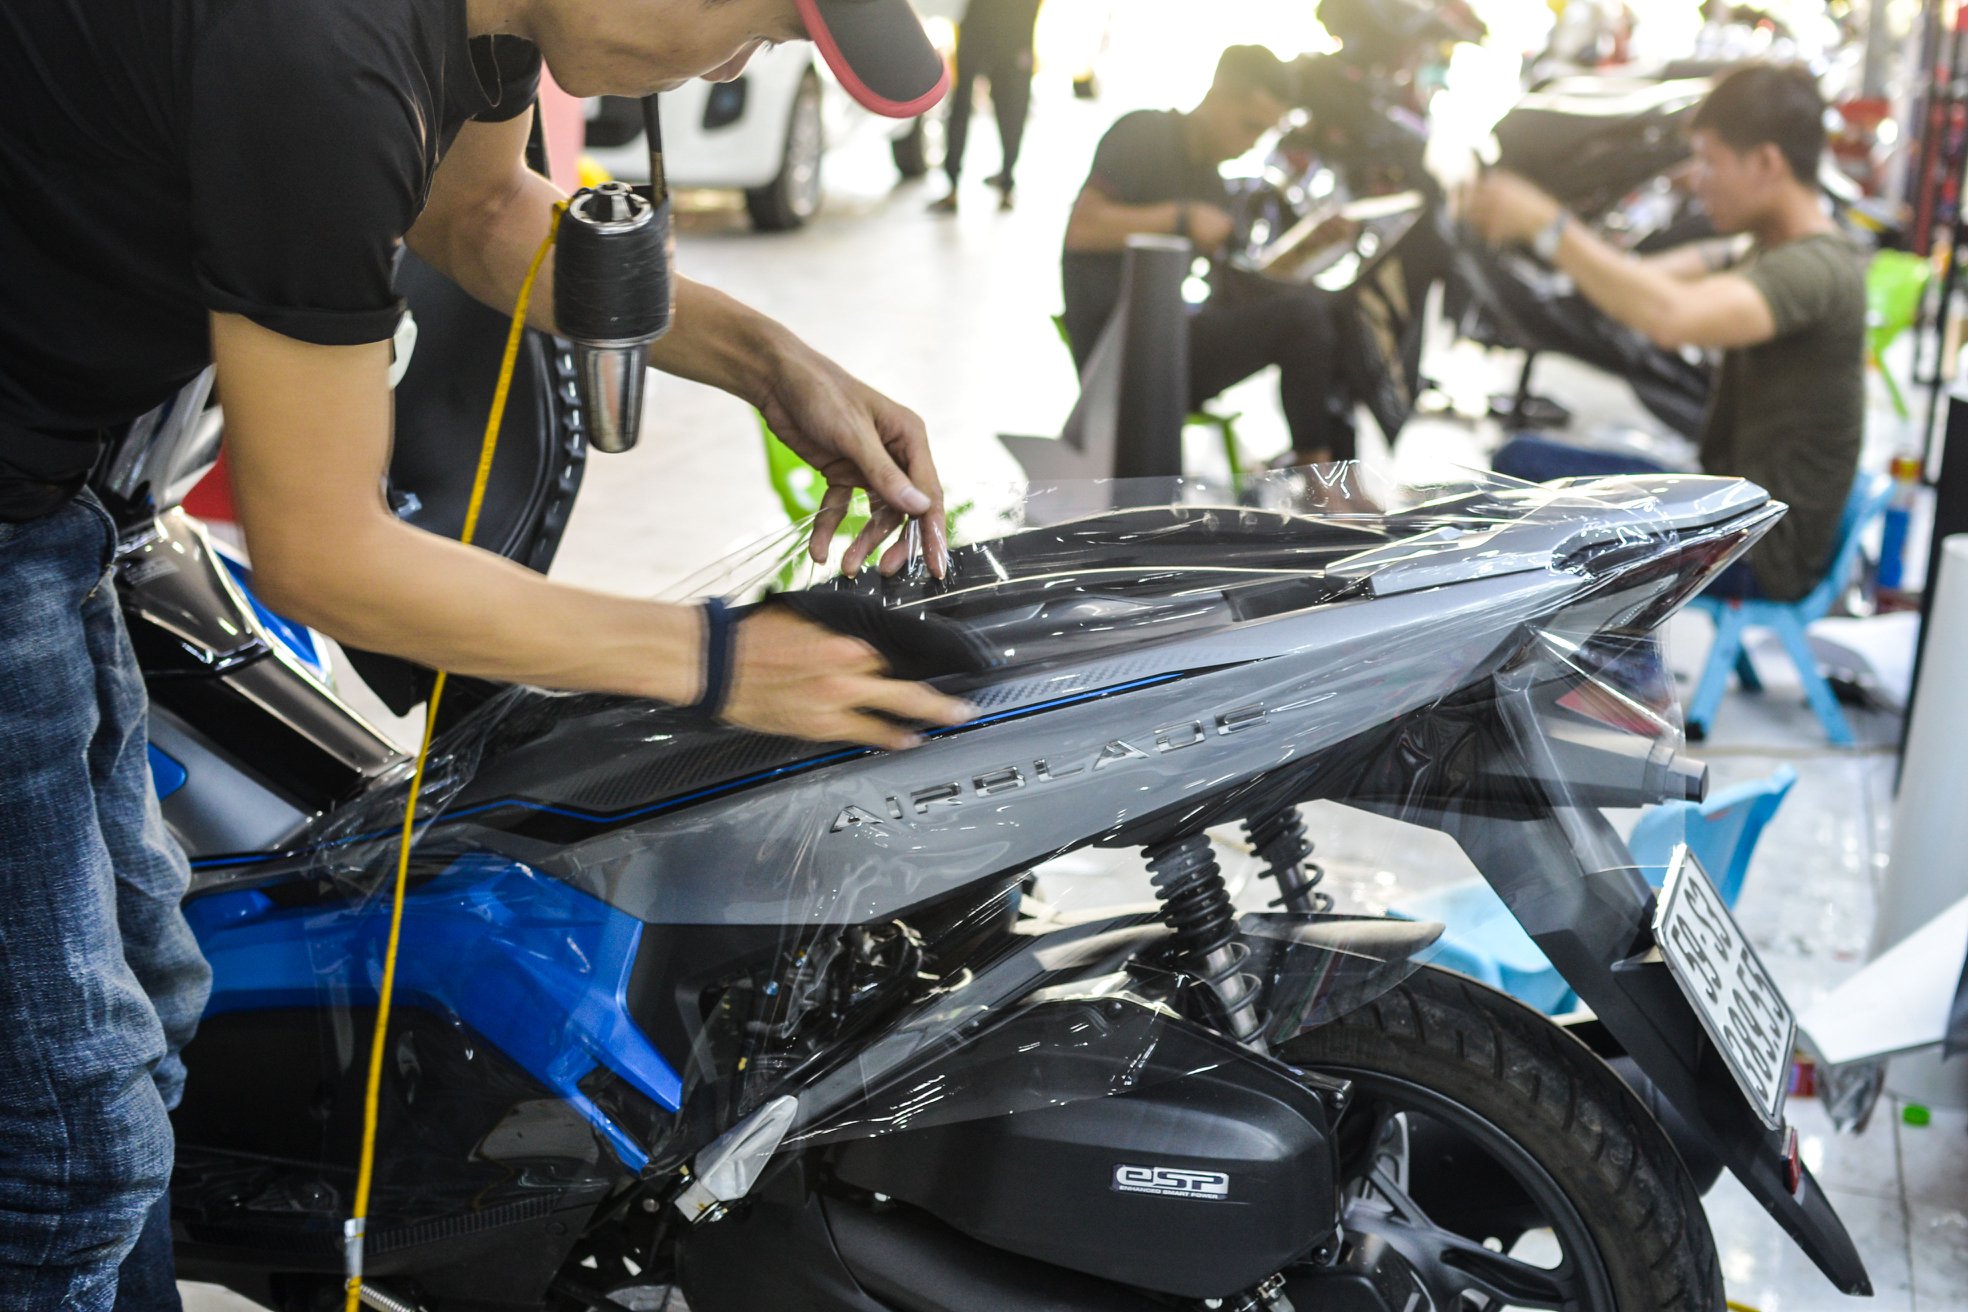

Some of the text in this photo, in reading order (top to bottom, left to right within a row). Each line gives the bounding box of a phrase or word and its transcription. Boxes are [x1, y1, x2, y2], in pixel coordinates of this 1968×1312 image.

[1722, 946, 1785, 1102] 389.55
[1119, 1185, 1218, 1200] ENHANCED SMART POWER
